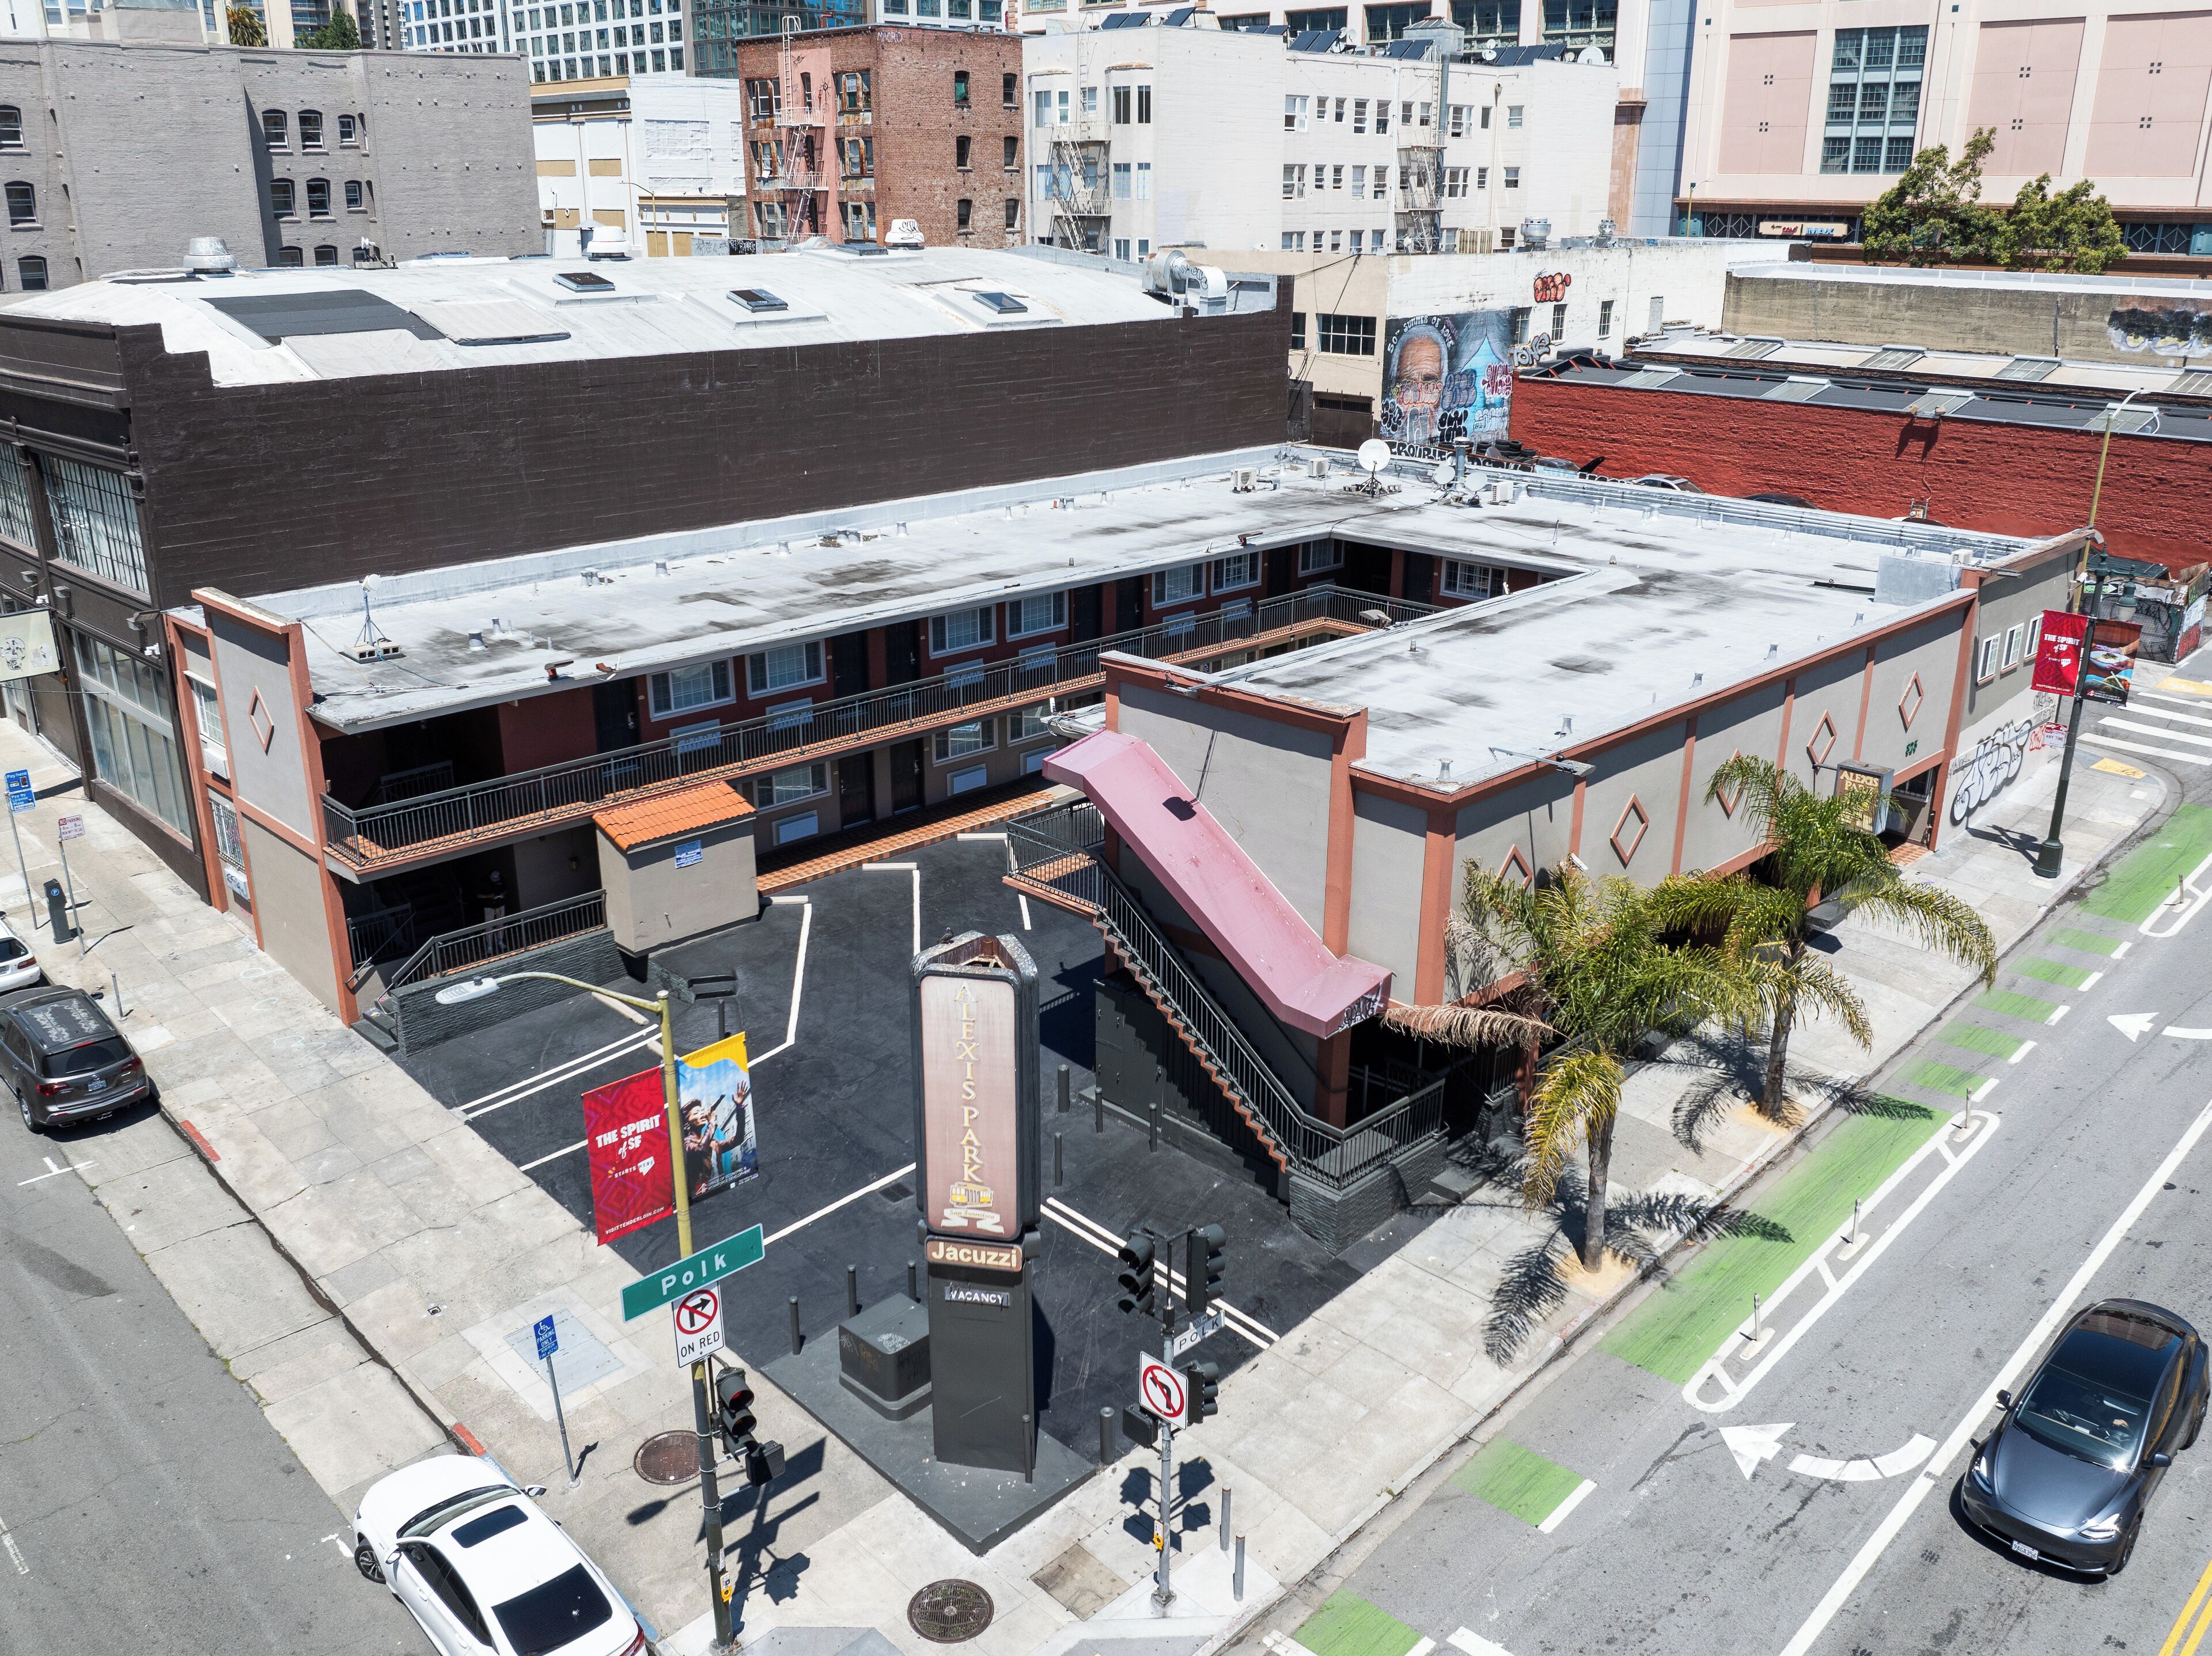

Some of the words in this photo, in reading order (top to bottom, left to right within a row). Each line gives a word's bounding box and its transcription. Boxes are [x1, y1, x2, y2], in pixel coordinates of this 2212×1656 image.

[1806, 227, 1834, 235] IMAX
[1403, 314, 1429, 333] SUMMER
[2044, 633, 2056, 642] THE
[2057, 635, 2080, 646] SPIRIT
[2053, 644, 2059, 653] of
[1840, 770, 1879, 787] ALEXIS
[955, 980, 979, 1100] ALEXIS
[596, 1129, 619, 1148] THE
[620, 1114, 660, 1139] SPIRIT
[618, 1140, 628, 1159] of
[627, 1135, 642, 1150] SF
[960, 1105, 983, 1183] PARK
[614, 1165, 637, 1178] STARTS
[931, 1241, 1017, 1268] Jacuzzi
[661, 1252, 727, 1297] Polk
[949, 1289, 1004, 1305] VACANCY
[536, 1329, 555, 1344] PARKING
[541, 1337, 552, 1347] ONLY
[1179, 1317, 1219, 1350] POLK
[680, 1342, 695, 1358] ON
[699, 1331, 720, 1349] RED
